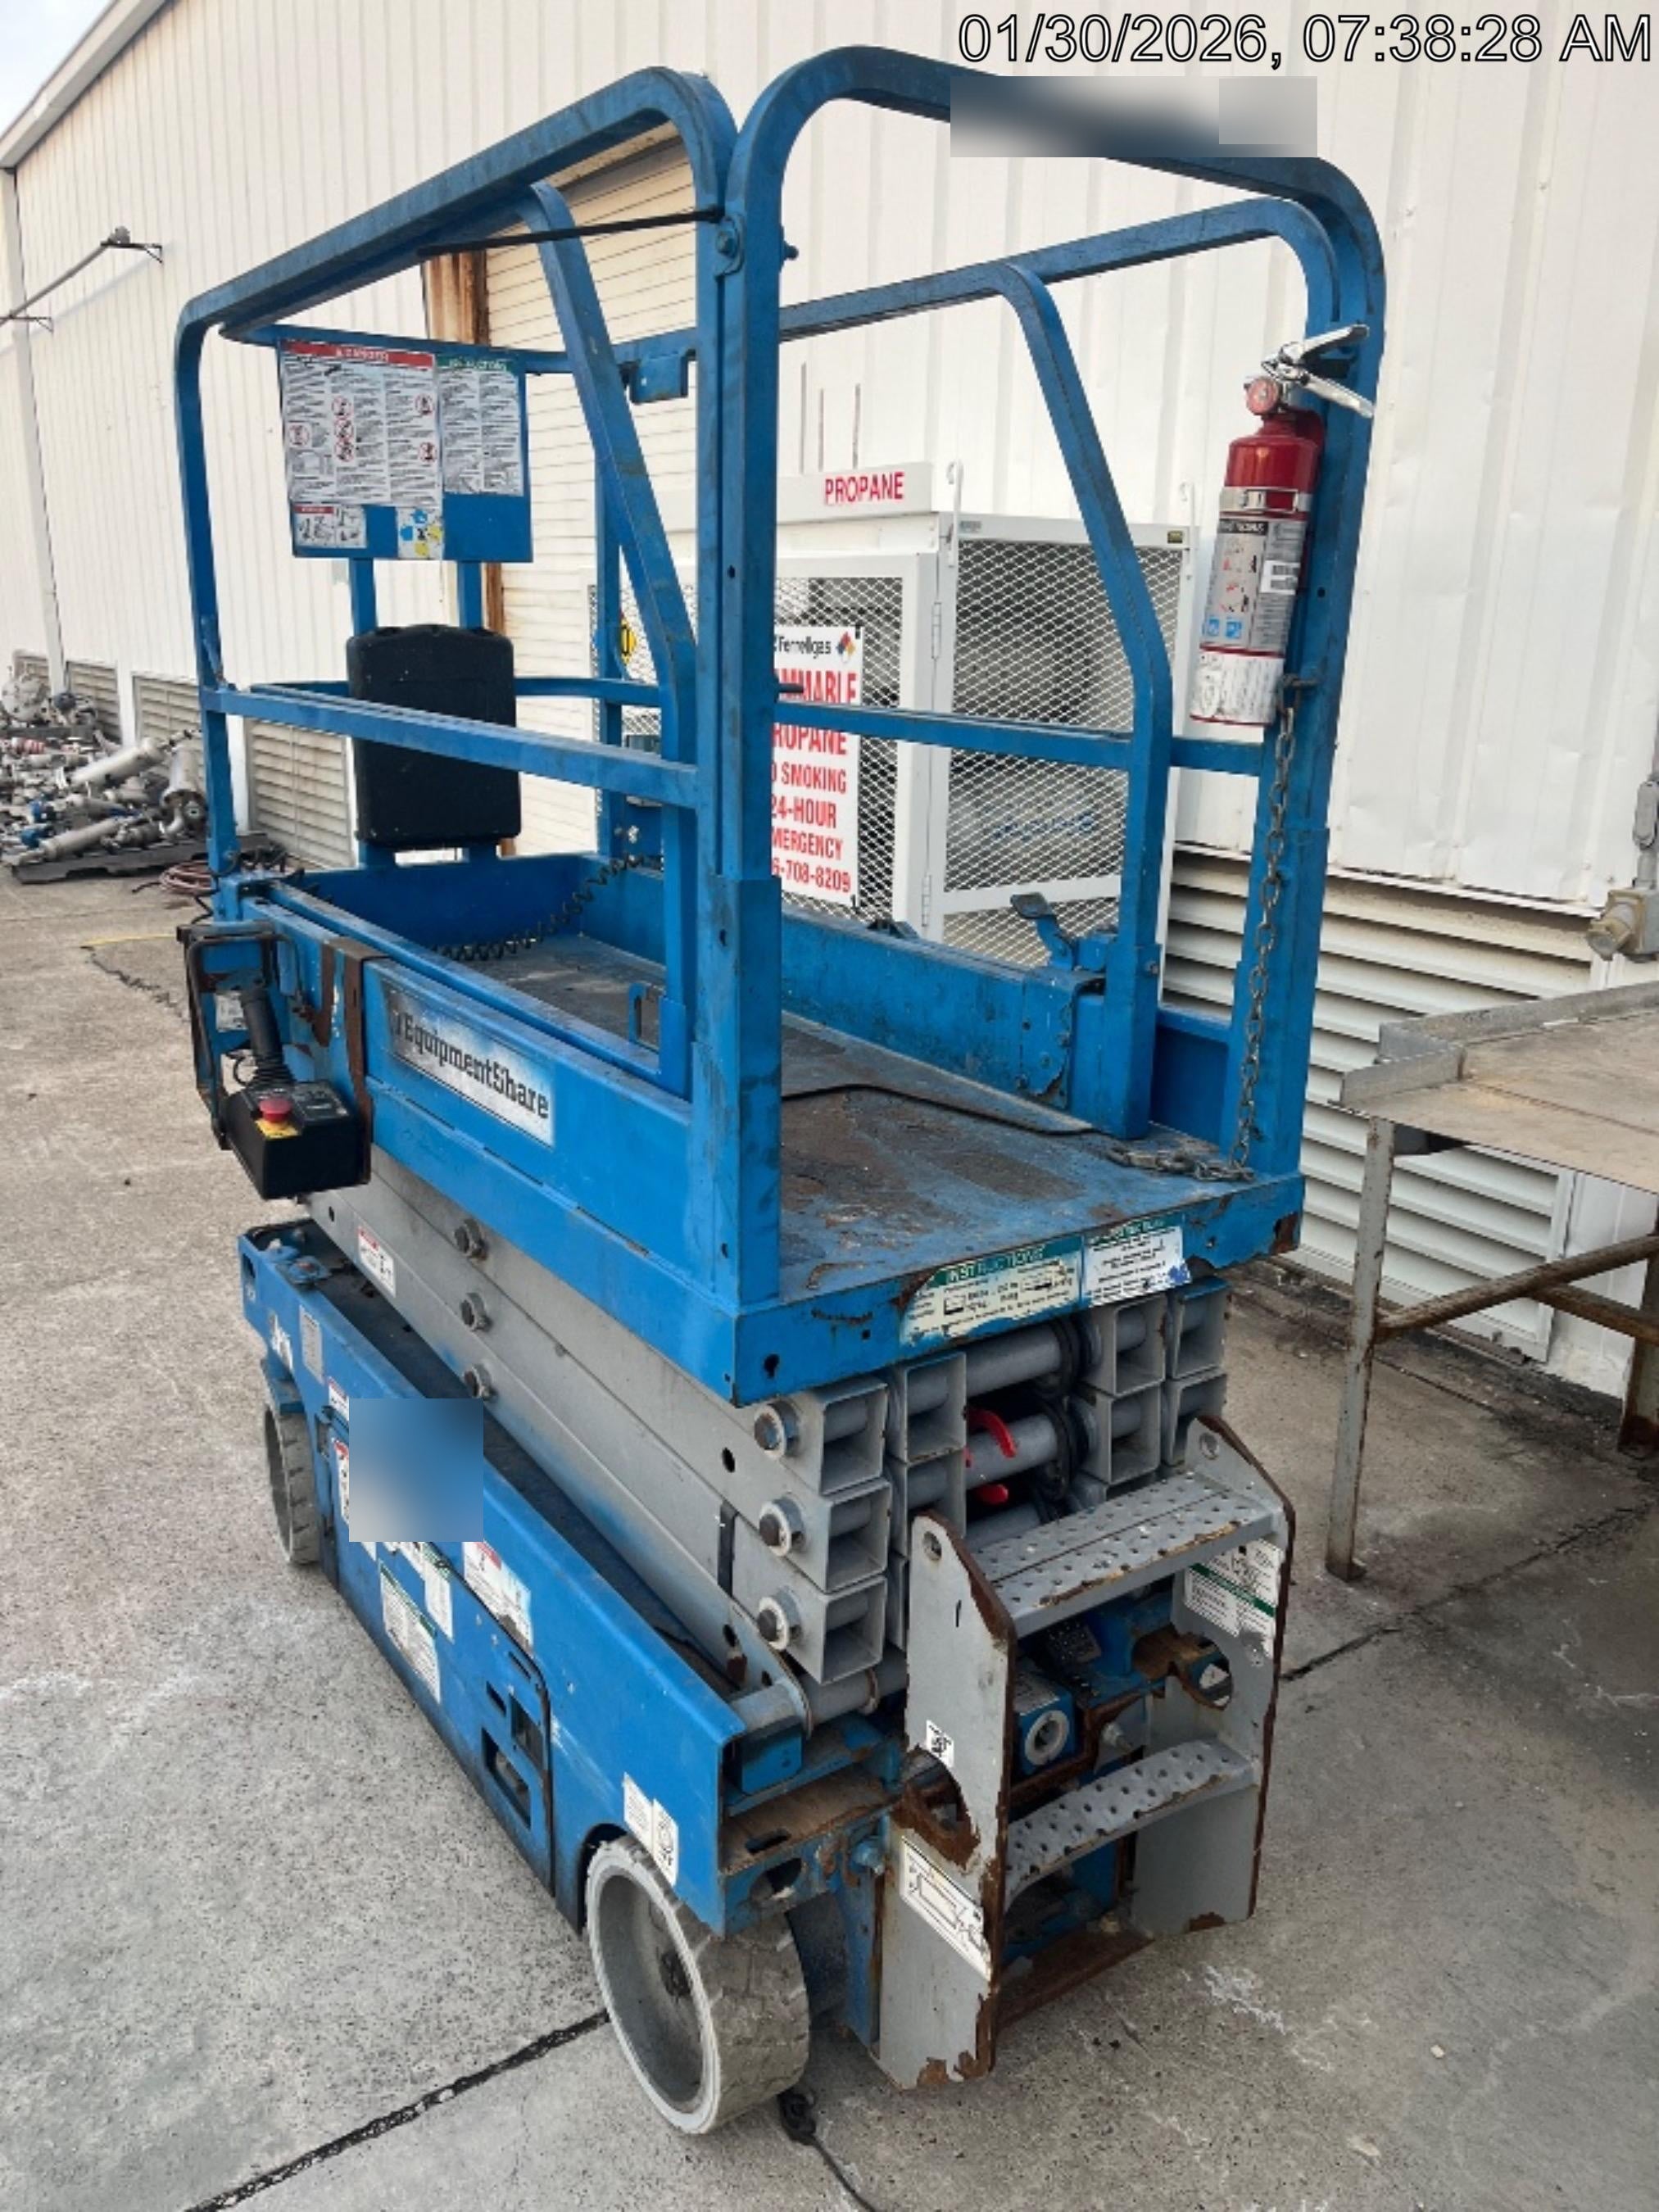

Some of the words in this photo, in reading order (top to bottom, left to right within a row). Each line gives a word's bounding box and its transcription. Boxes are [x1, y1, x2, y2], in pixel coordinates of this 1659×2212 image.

[825, 471, 904, 505] PROPANE
[778, 636, 832, 659] Ferrellgas
[778, 668, 857, 704] MMABLE
[772, 723, 847, 755] ROPANE
[782, 762, 846, 794] SMOKING
[772, 827, 843, 860] MERGENCY
[772, 857, 851, 893] 6-708-8209
[405, 1013, 549, 1119] EquipmentShare
